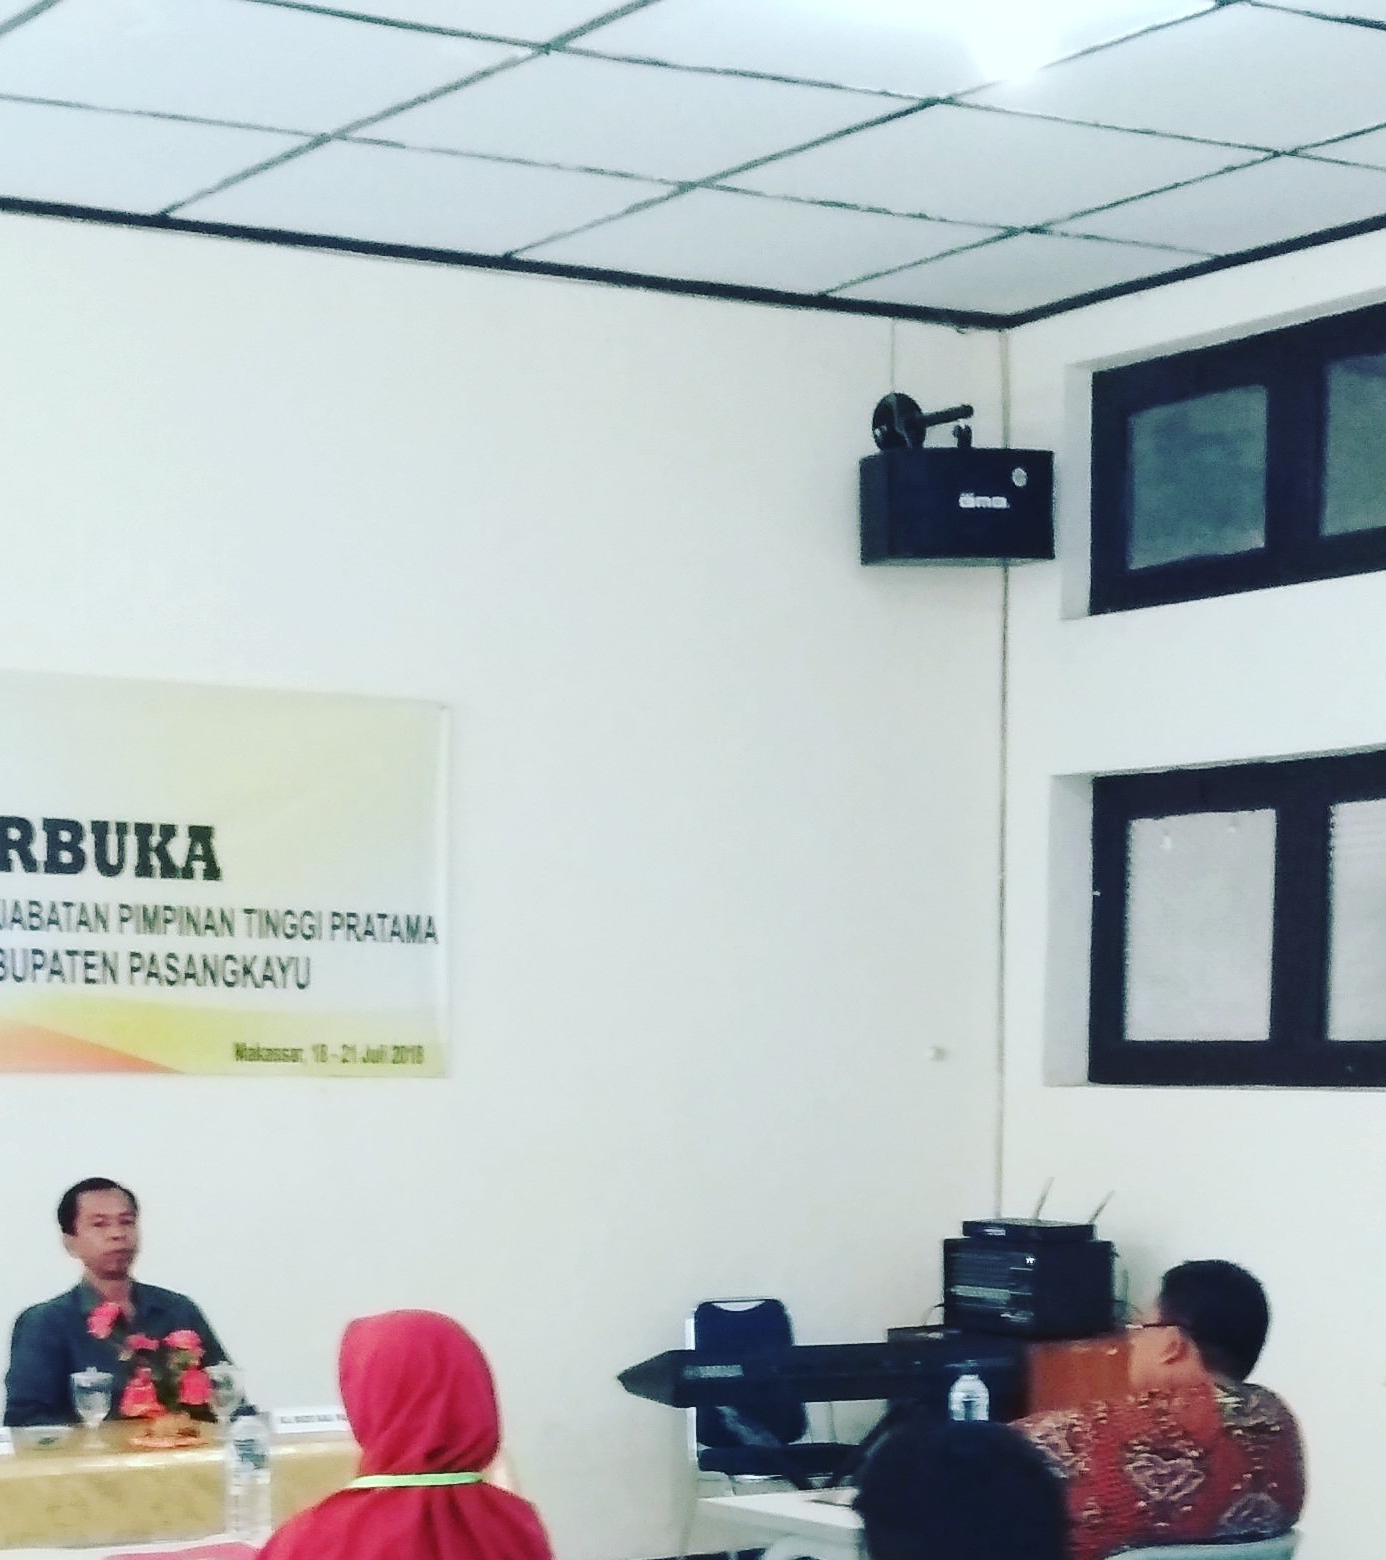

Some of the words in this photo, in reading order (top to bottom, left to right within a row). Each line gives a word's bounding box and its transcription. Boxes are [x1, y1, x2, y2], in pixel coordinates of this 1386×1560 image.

[118, 903, 235, 938] PIMPINAN
[243, 908, 323, 942] TINGGI
[330, 911, 440, 945] PRATAMA
[129, 950, 311, 990] PASANGKAYU
